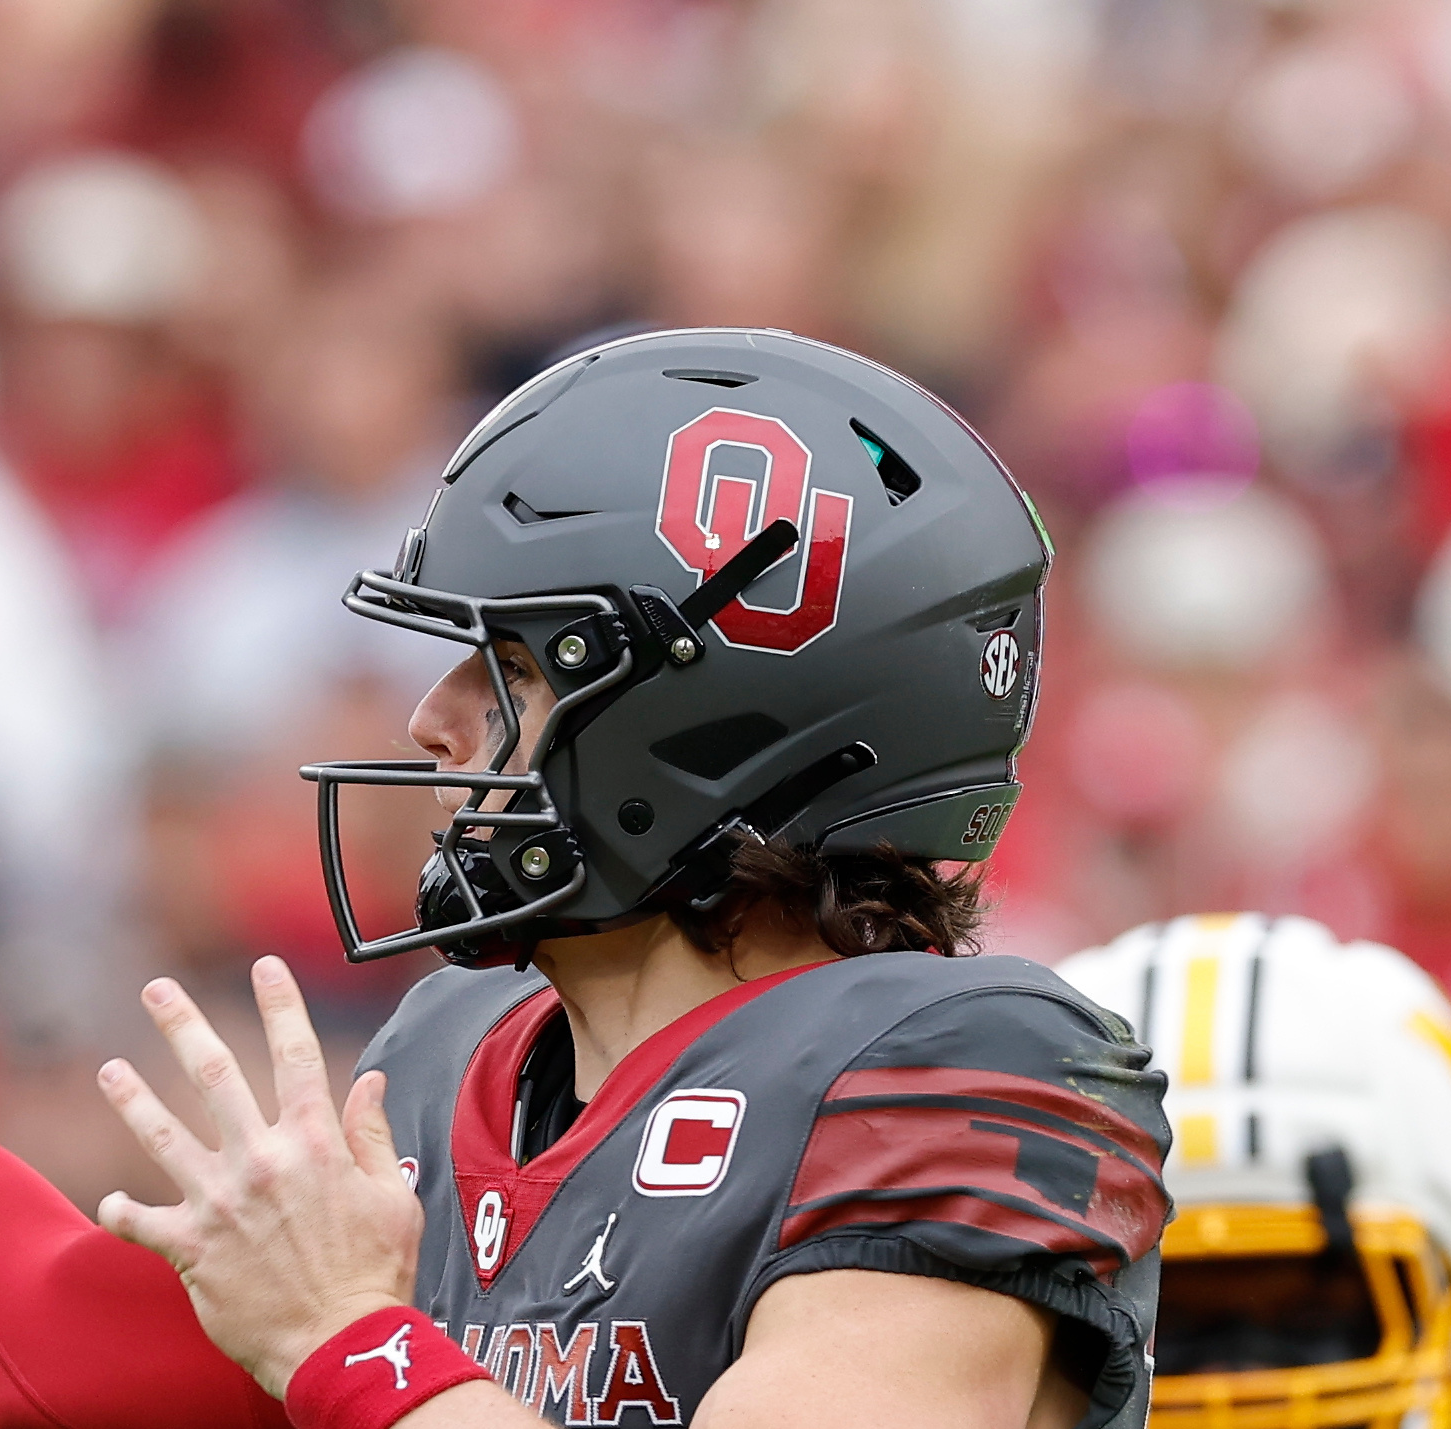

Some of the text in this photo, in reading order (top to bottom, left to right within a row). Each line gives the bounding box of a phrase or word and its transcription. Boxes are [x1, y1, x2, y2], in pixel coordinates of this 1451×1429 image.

[654, 406, 854, 657] OU
[981, 632, 1020, 698] SEC
[638, 1098, 740, 1188] C
[473, 1190, 507, 1271] OU
[434, 1318, 682, 1426] HOMA
